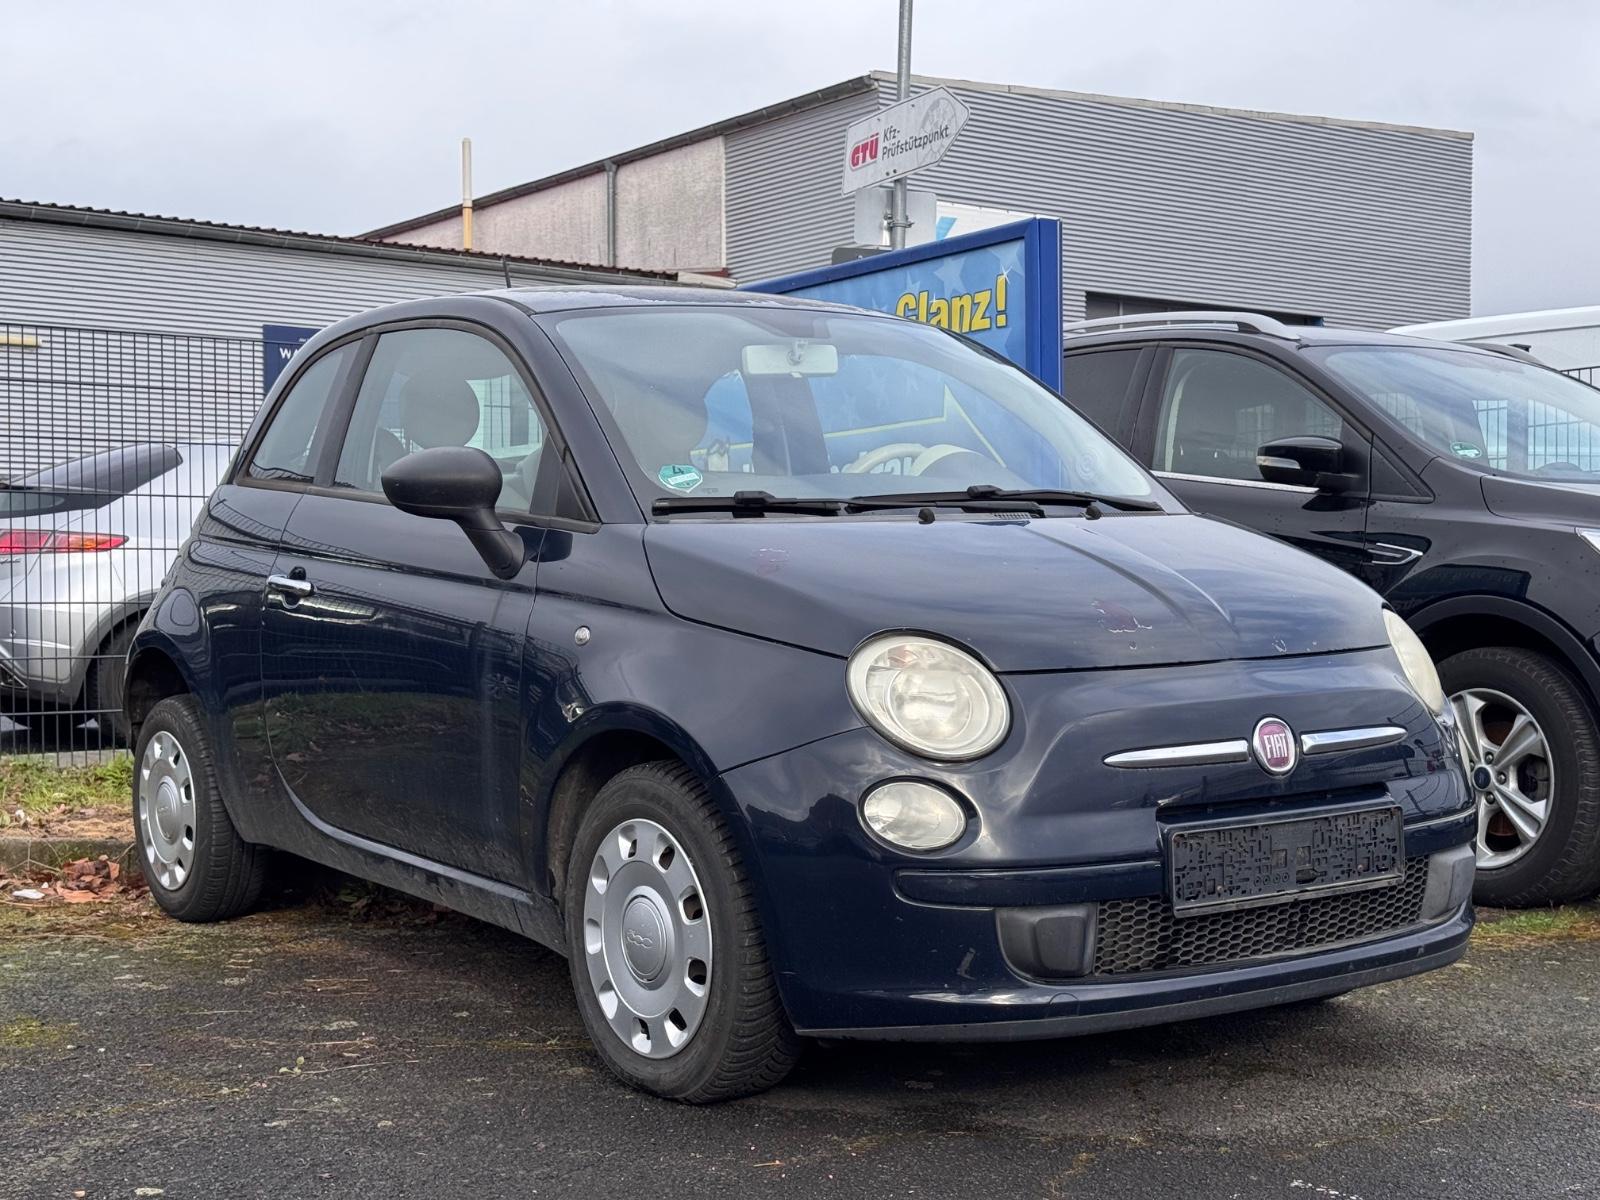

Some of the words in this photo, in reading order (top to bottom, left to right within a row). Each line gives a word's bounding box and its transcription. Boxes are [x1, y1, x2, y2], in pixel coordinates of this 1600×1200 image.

[850, 132, 879, 167] GTÜ
[882, 124, 949, 160] Prüfstützpunkt
[883, 126, 900, 143] Kfz-
[895, 273, 1007, 334] Glanz!
[1263, 733, 1288, 758] FIAT
